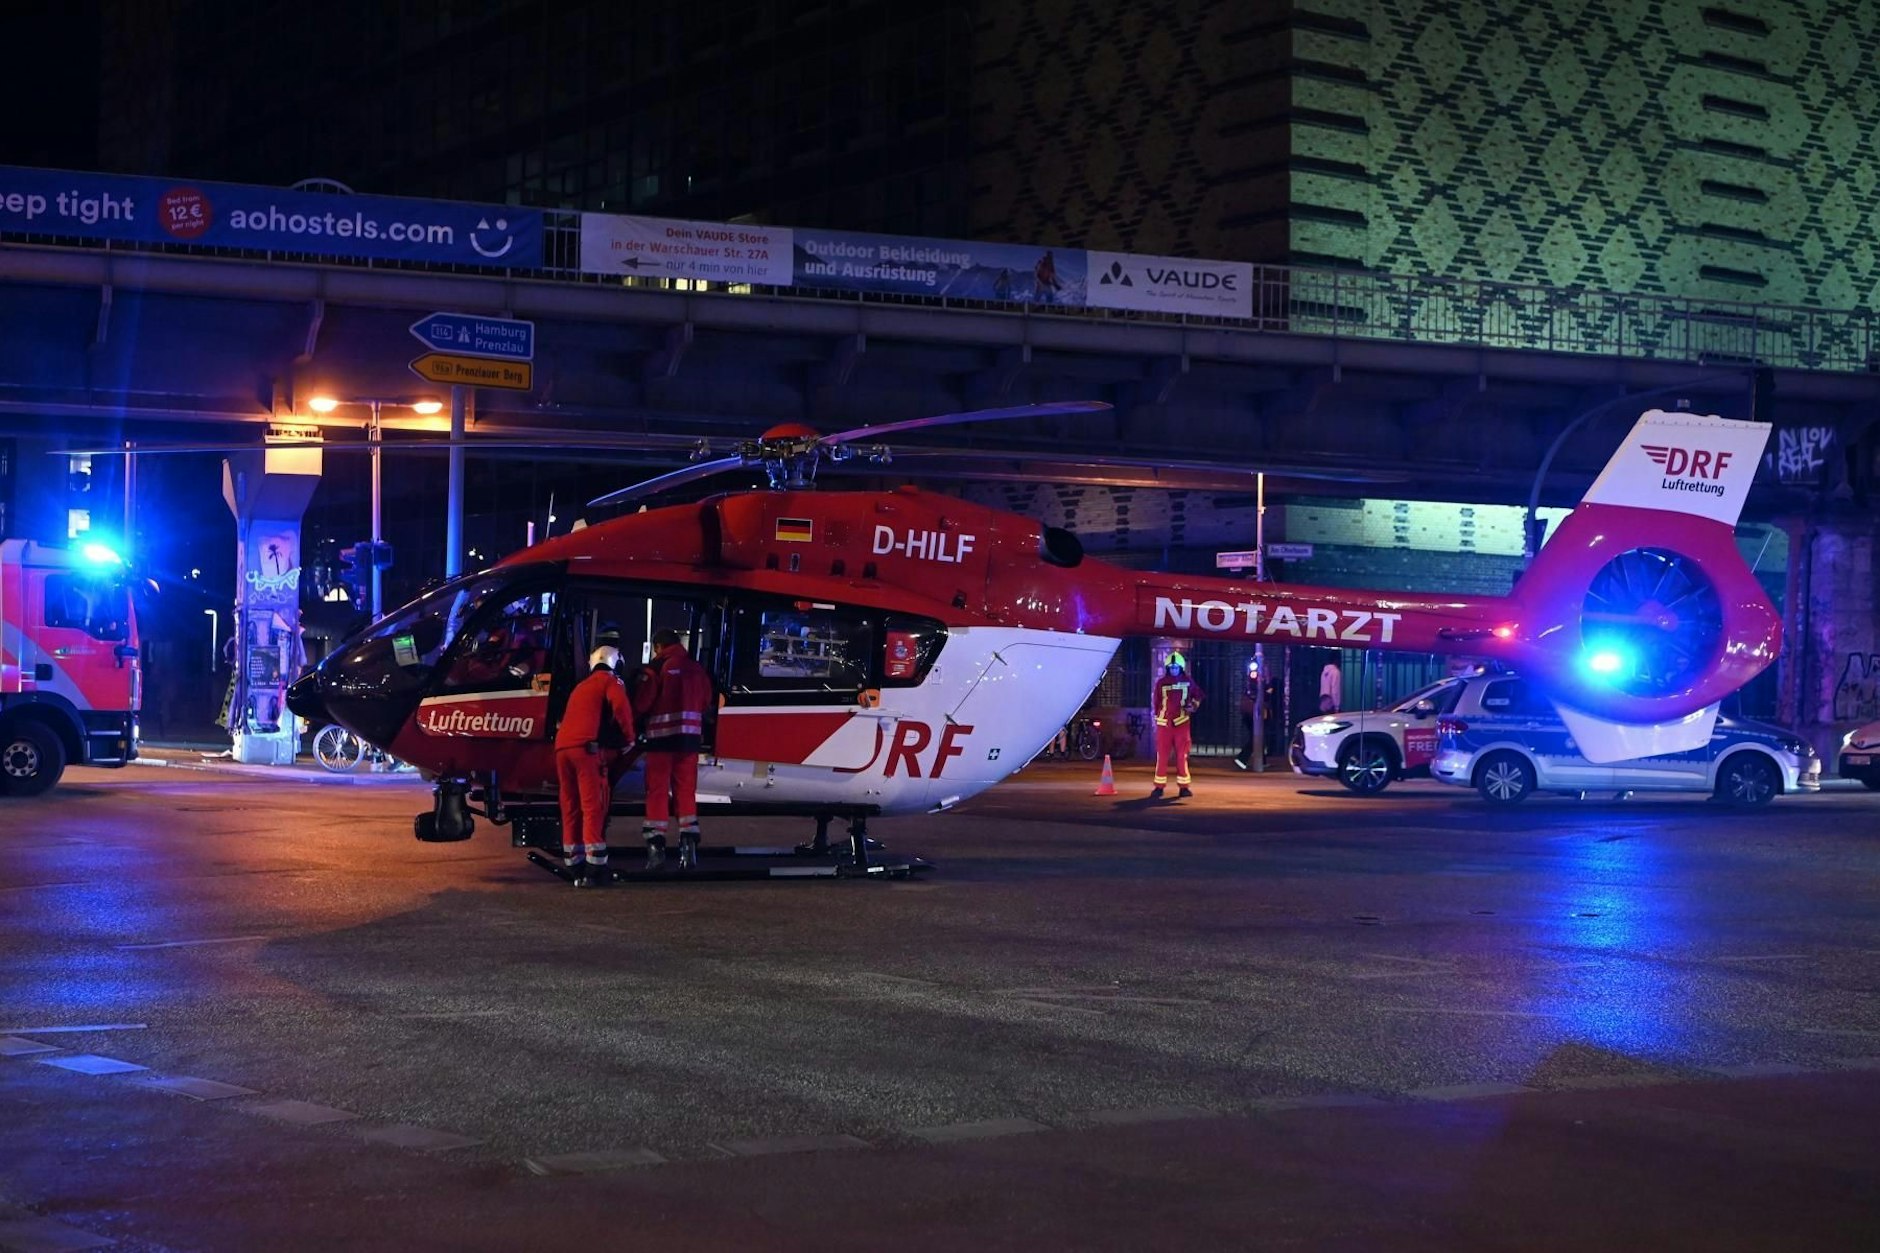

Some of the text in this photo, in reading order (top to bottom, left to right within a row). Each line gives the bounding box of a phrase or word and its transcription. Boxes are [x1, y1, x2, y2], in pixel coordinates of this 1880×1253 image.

[0, 189, 134, 225] ep tight
[169, 206, 188, 220] 12
[230, 205, 454, 245] aohostels.com
[666, 228, 769, 245] Dein VAUDE Store
[611, 239, 768, 260] in der Warschauer Str. 27A
[805, 239, 971, 270] Outdoor Bekleidung
[666, 261, 768, 276] nur 4 min von hier
[805, 261, 937, 286] und Ausrüstung
[1146, 268, 1237, 291] VAUDE
[475, 322, 527, 341] Hamburg
[475, 338, 524, 353] Prenzlau
[456, 364, 523, 384] Prenzlauer Berg
[1665, 447, 1732, 480] DRF
[1661, 478, 1725, 498] Luftrettung
[872, 525, 976, 563] D-HILF
[1153, 597, 1403, 643] NOTARZT
[428, 709, 535, 738] Luftrettung
